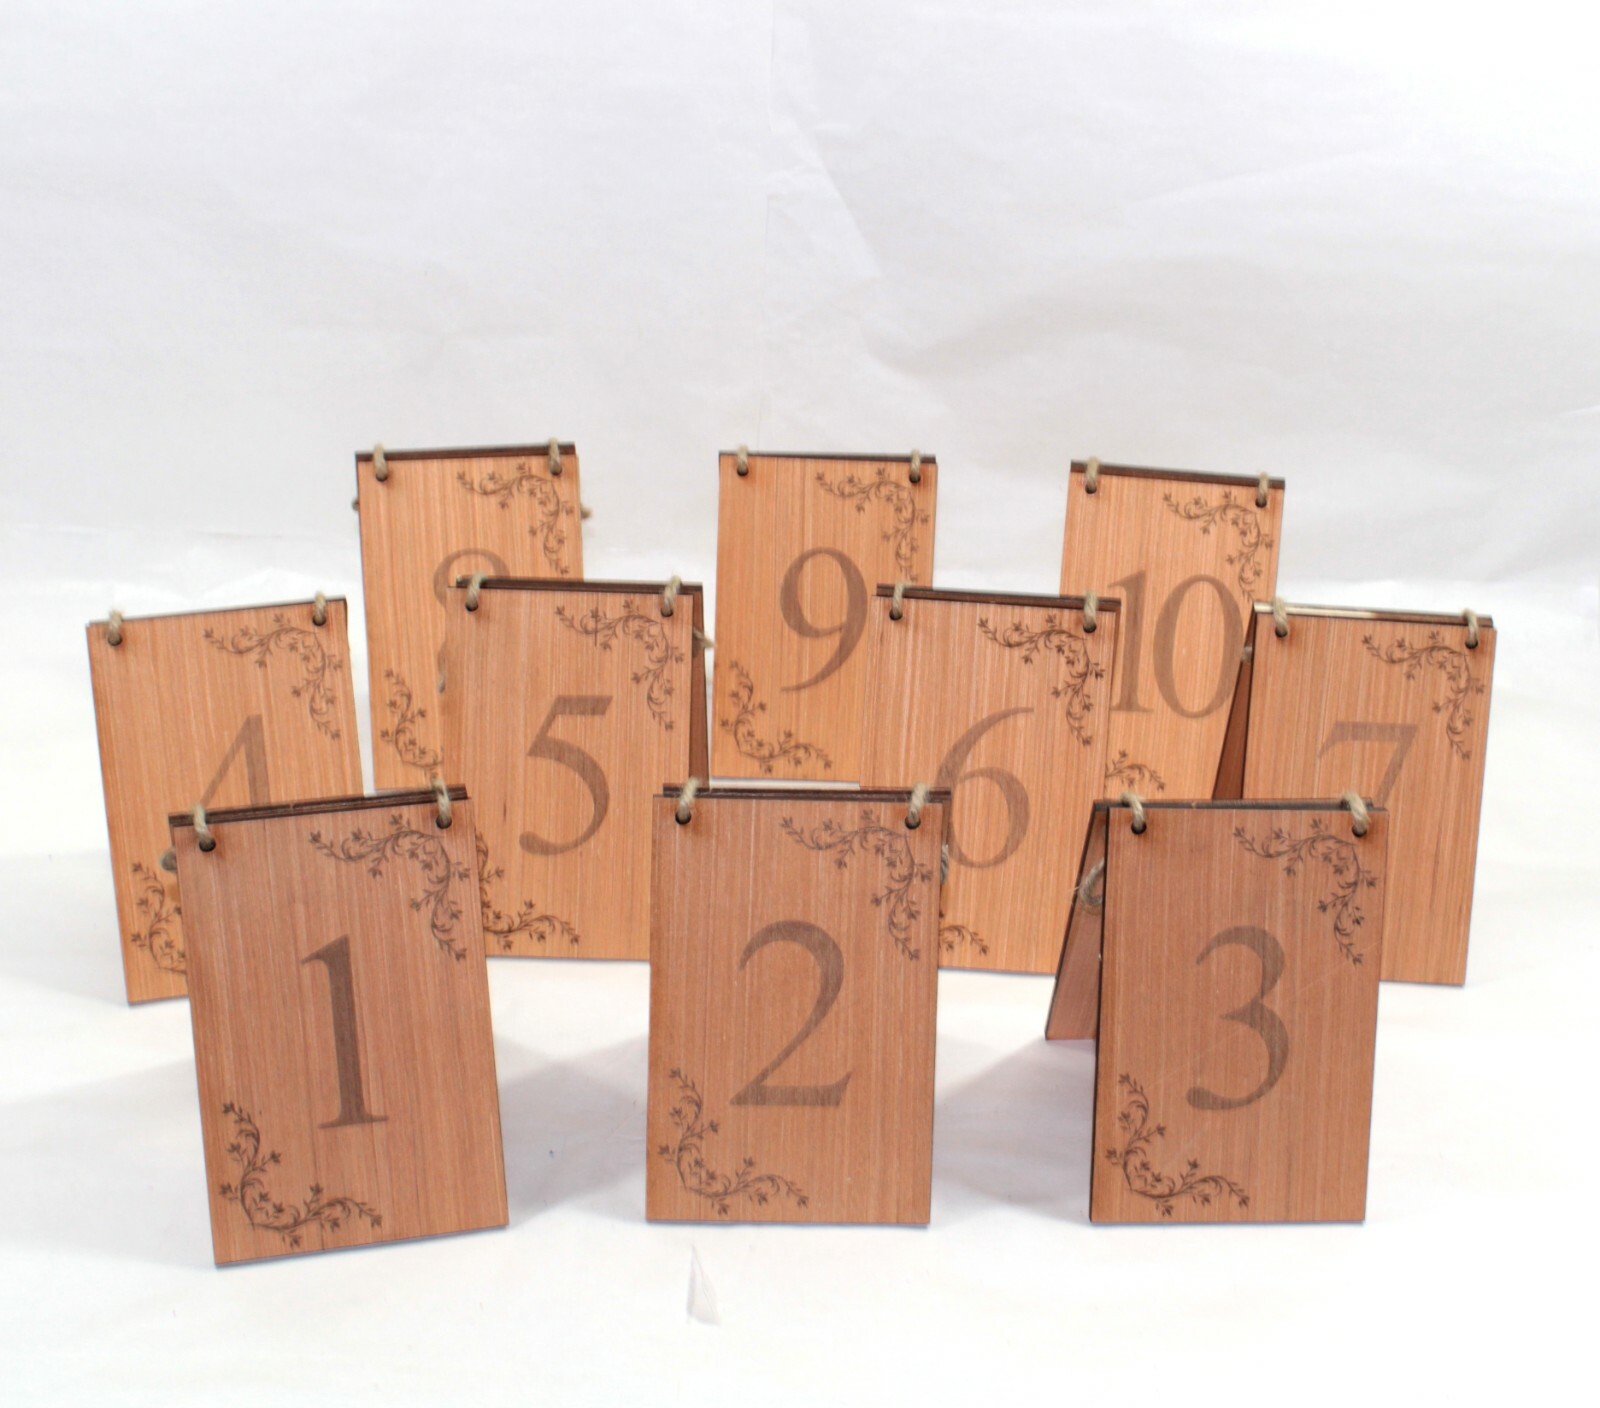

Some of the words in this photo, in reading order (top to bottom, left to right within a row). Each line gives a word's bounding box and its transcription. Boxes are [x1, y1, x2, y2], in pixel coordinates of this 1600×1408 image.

[780, 547, 868, 690] 9
[1109, 570, 1244, 718] 10
[520, 695, 611, 855] 5
[937, 707, 1034, 869] 6
[1317, 721, 1418, 808] 7
[301, 934, 388, 1129] 1
[730, 920, 852, 1107] 2
[1187, 926, 1290, 1110] 3
